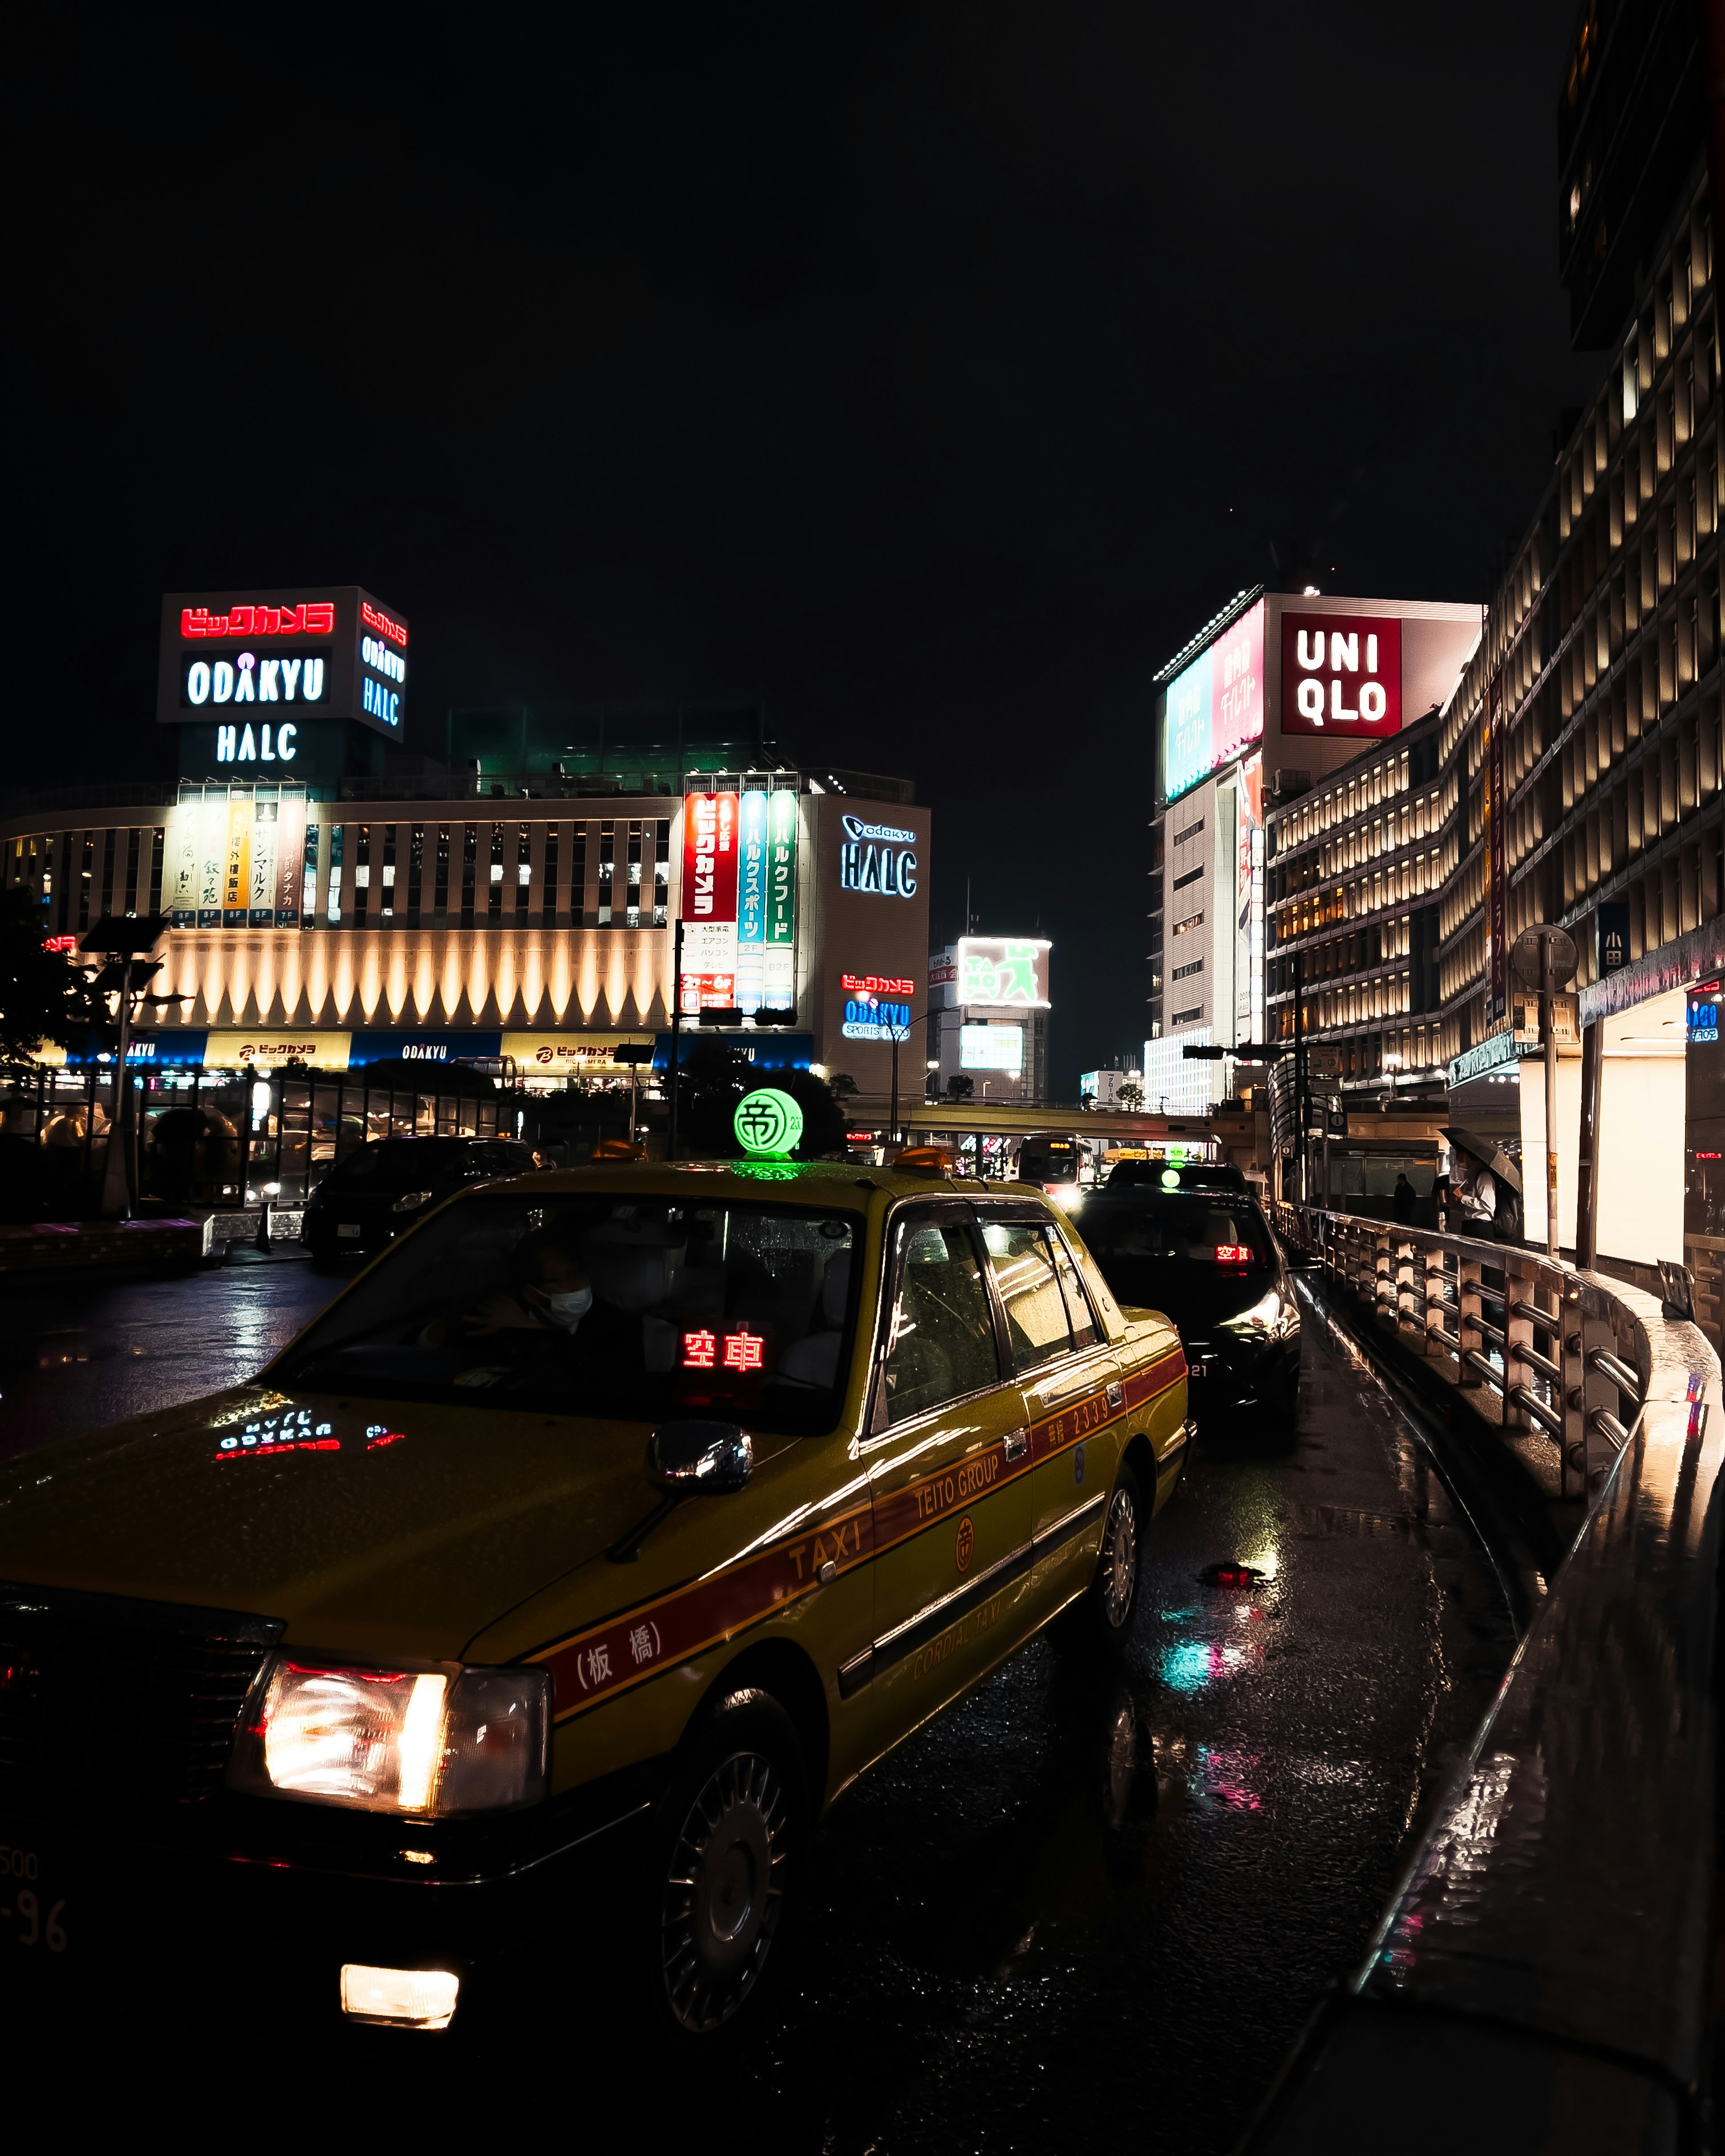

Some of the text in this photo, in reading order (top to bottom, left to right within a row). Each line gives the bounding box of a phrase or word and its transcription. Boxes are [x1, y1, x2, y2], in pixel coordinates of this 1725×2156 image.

[181, 602, 335, 639] ビックカメラ
[362, 601, 408, 647] ビックカメラ
[362, 639, 405, 683] ODAKYU
[1297, 629, 1378, 674] UNI
[187, 653, 323, 704] ODAKYU
[362, 677, 398, 726] HALC
[1297, 678, 1387, 726] QLO
[217, 723, 297, 761] HALC
[866, 825, 915, 840] odakyu
[253, 829, 268, 901] サンマルク
[694, 799, 716, 914] ビックカメラ
[841, 844, 917, 898] HALC
[744, 828, 761, 938] ハルクスポーツ
[774, 828, 789, 939] ハルクフード
[1605, 932, 1622, 972] 小田
[841, 974, 915, 995] ビックカメラ
[845, 998, 910, 1026] ODAKYU
[847, 1026, 909, 1037] SPORTS FOOD
[126, 1041, 155, 1056] AKYU
[259, 1044, 316, 1054] ビックカメラ
[402, 1043, 447, 1059] ODAKYU
[557, 1046, 618, 1056] ビックカメラ
[683, 1330, 764, 1371] 空車
[1074, 1396, 1108, 1434] 2339
[914, 1454, 999, 1519] TEITO GROUP
[788, 1520, 862, 1579] TAXI
[914, 1598, 1000, 1681] CORDIAL TAXI
